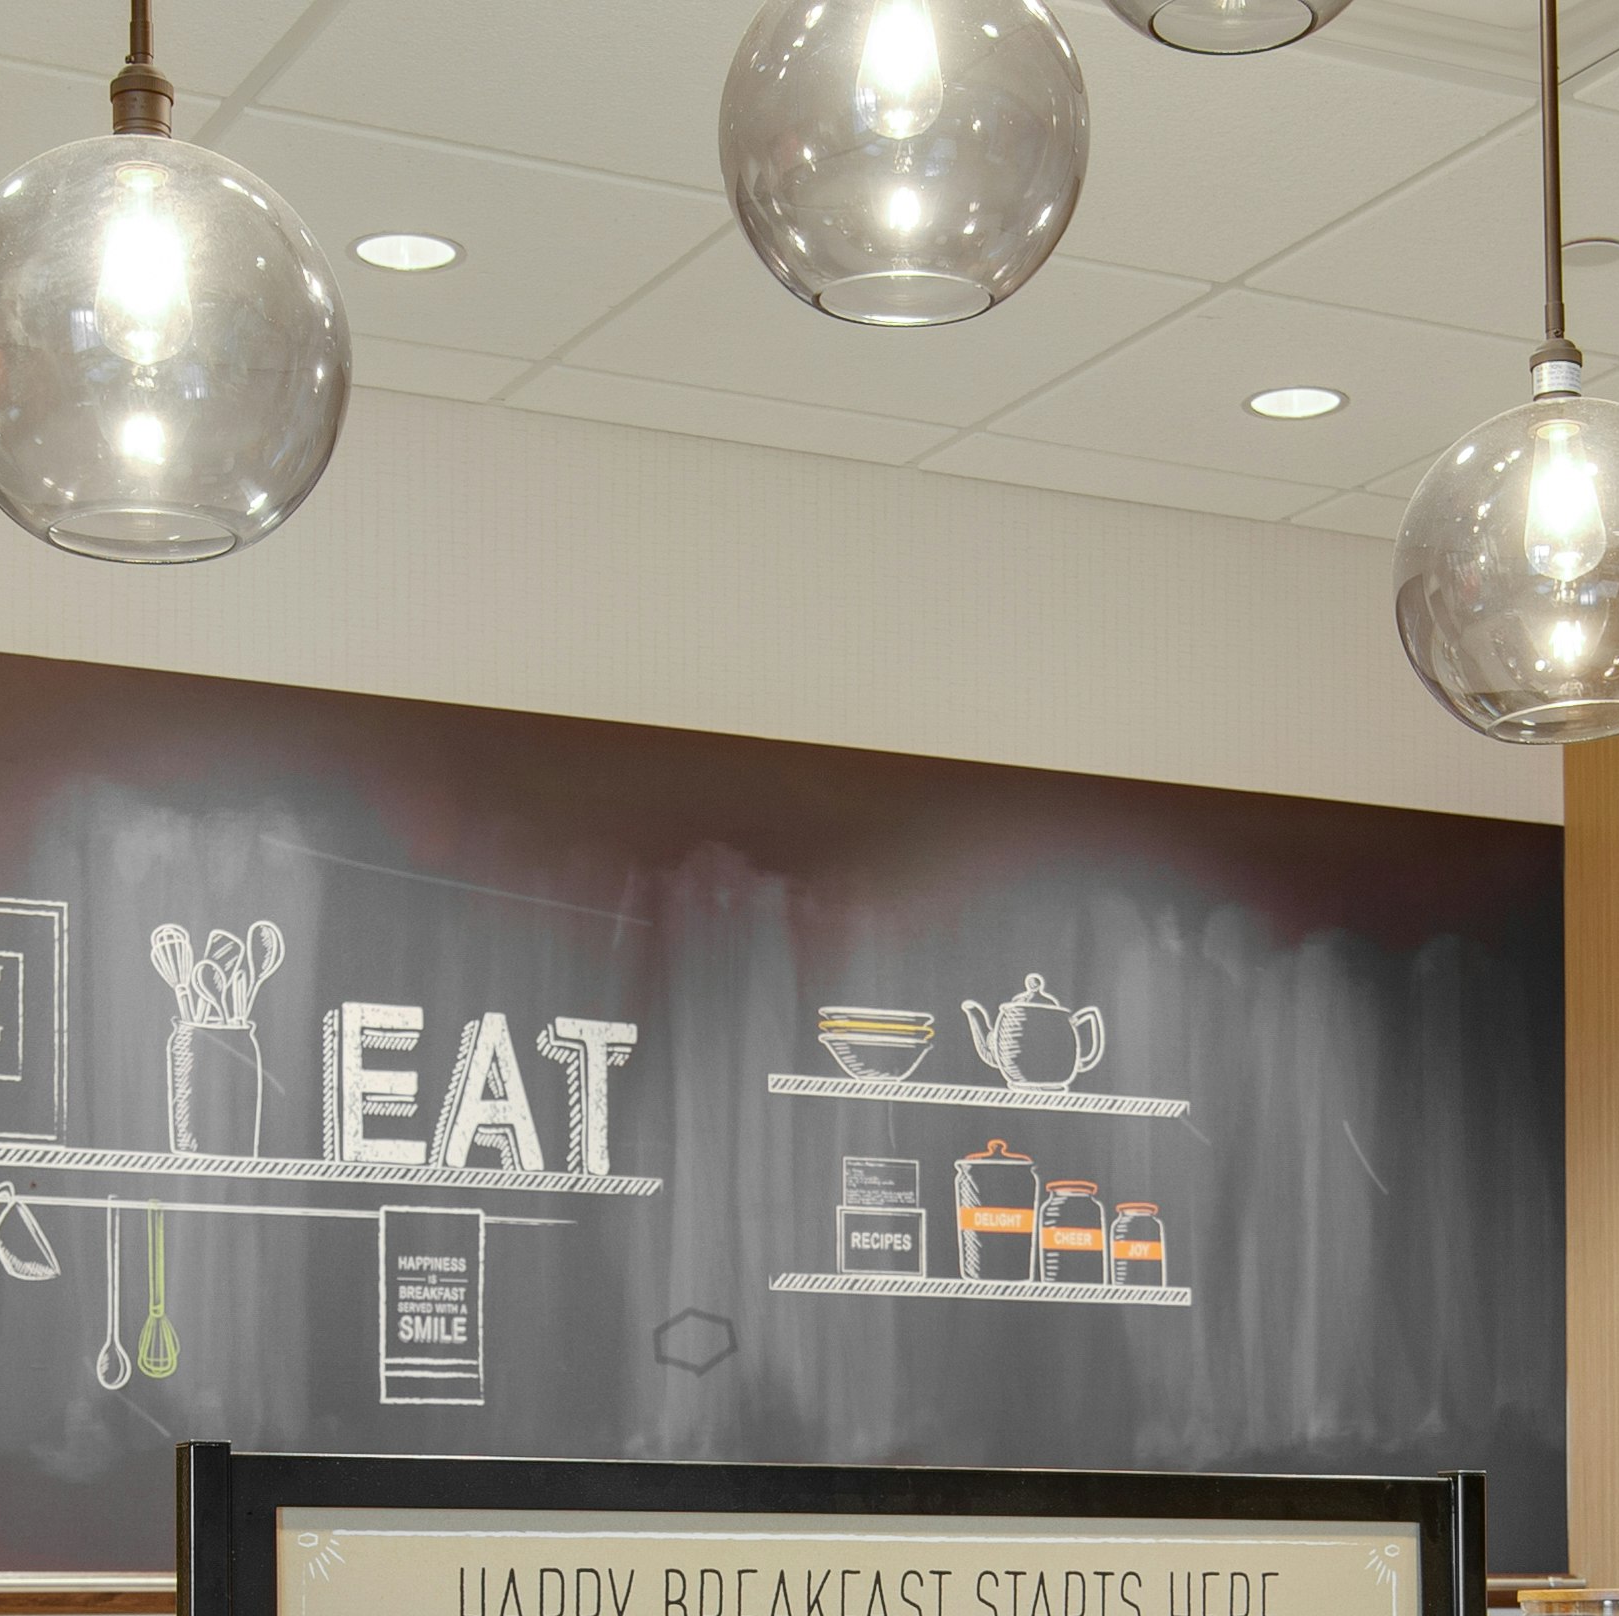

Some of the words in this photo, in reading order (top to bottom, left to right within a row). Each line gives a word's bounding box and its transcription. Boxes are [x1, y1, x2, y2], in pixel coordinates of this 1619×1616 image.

[323, 1001, 638, 1176] EAT
[973, 1212, 1022, 1227] DELIGHT
[851, 1231, 912, 1252] RECIPES
[1053, 1230, 1092, 1246] CHEER
[1128, 1243, 1151, 1257] JOY
[398, 1256, 467, 1272] HAPPINESS
[428, 1274, 437, 1285] IS
[399, 1285, 466, 1302] BREAKFAST
[398, 1301, 433, 1313] SERVED
[435, 1303, 459, 1314] WITH
[460, 1304, 468, 1315] A
[398, 1315, 468, 1344] SMILE
